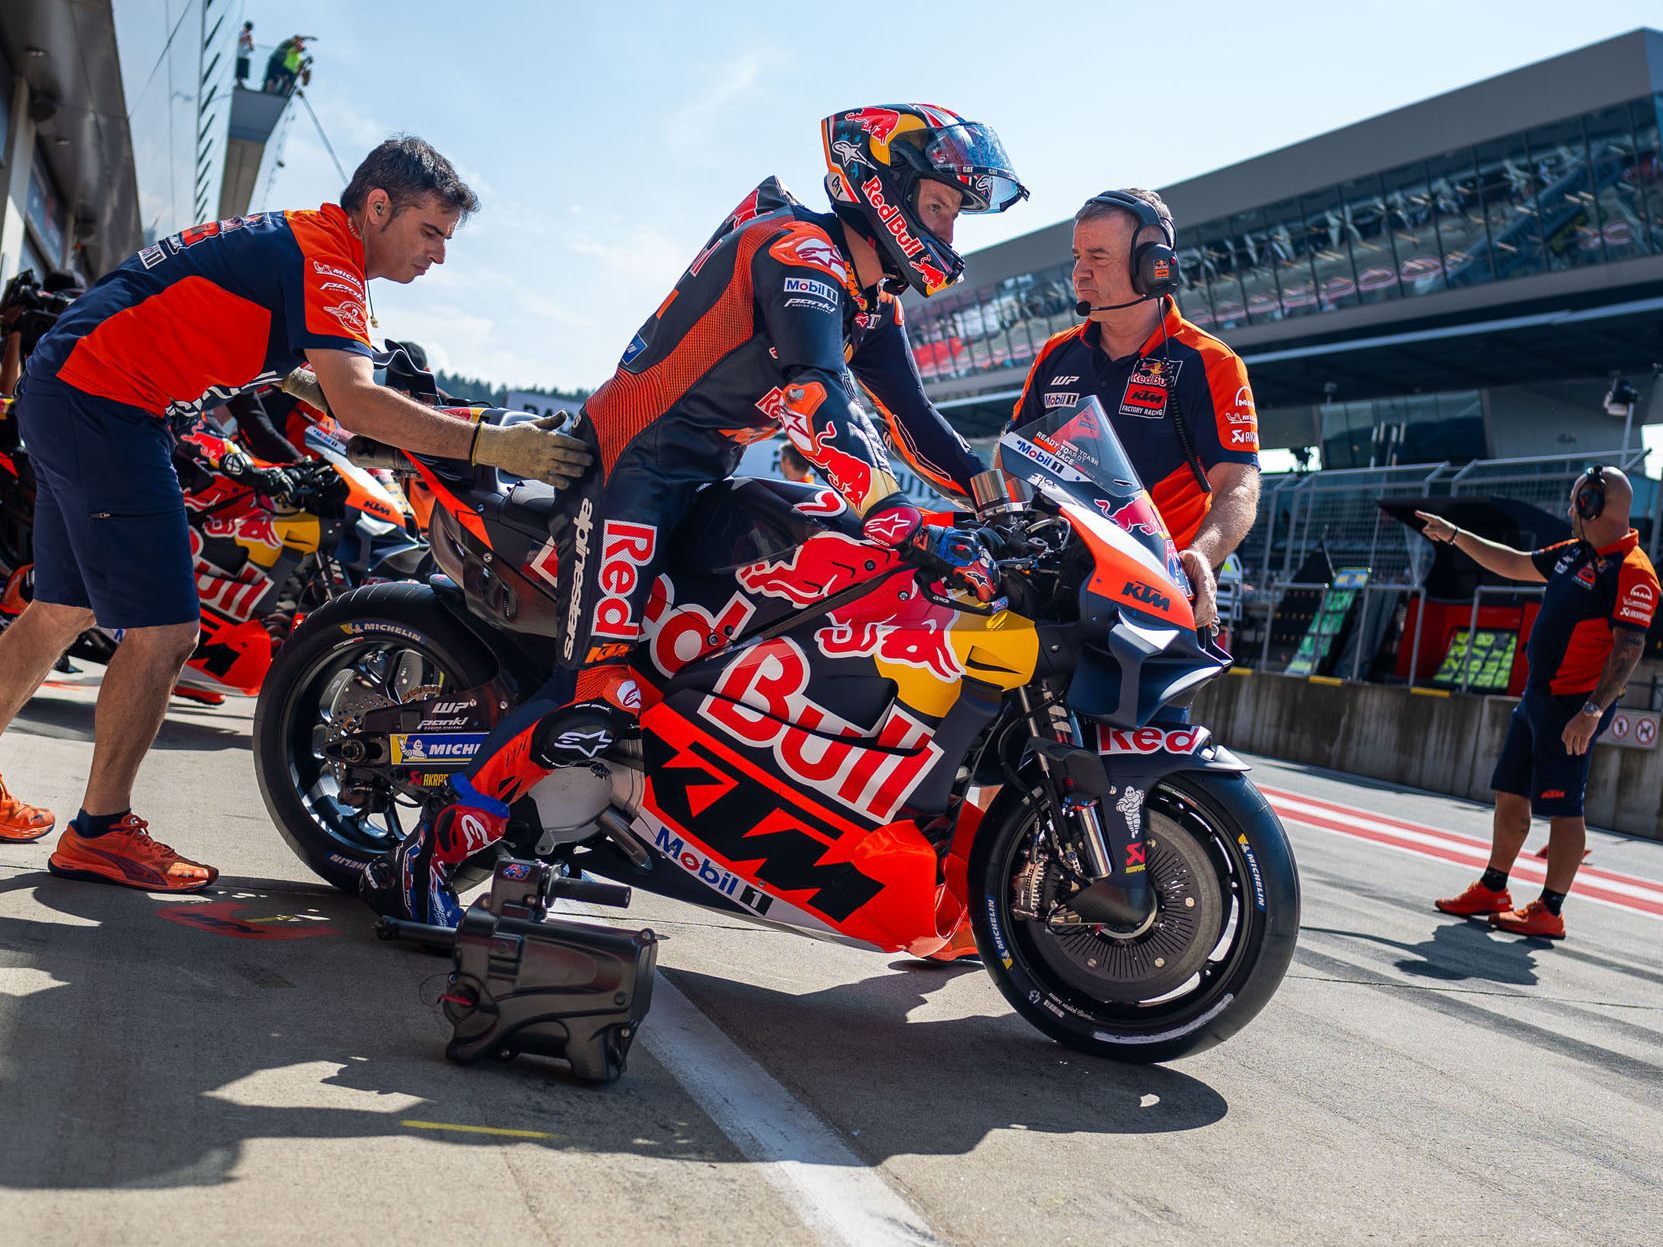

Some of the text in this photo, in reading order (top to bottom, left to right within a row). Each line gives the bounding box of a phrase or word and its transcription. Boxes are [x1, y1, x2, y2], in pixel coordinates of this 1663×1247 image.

[832, 176, 843, 197] CAT
[861, 175, 926, 258] Red Bull
[786, 280, 825, 293] Mobil
[1050, 376, 1080, 386] WP
[1131, 372, 1152, 384] Red
[755, 386, 785, 420] Re
[1046, 394, 1066, 406] Mobil
[1131, 390, 1163, 403] KTM
[1121, 404, 1163, 416] FACTORY RACING
[1036, 431, 1061, 449] READY
[1018, 441, 1048, 467] Mobil
[1054, 450, 1074, 466] RACE
[363, 499, 391, 515] KTM
[564, 498, 593, 661] alpinestars
[591, 519, 658, 641] Red
[1120, 580, 1170, 613] KTM
[363, 623, 422, 641] MICHELIN
[585, 642, 632, 664] KTM
[431, 702, 470, 714] WP
[416, 716, 469, 730] pankl
[697, 636, 945, 826] Bull
[428, 743, 481, 755] MICH
[641, 728, 887, 924] KTM
[654, 825, 738, 897] Mobil
[1246, 853, 1265, 907] MICHELIN
[988, 899, 1005, 949] MICHELIN
